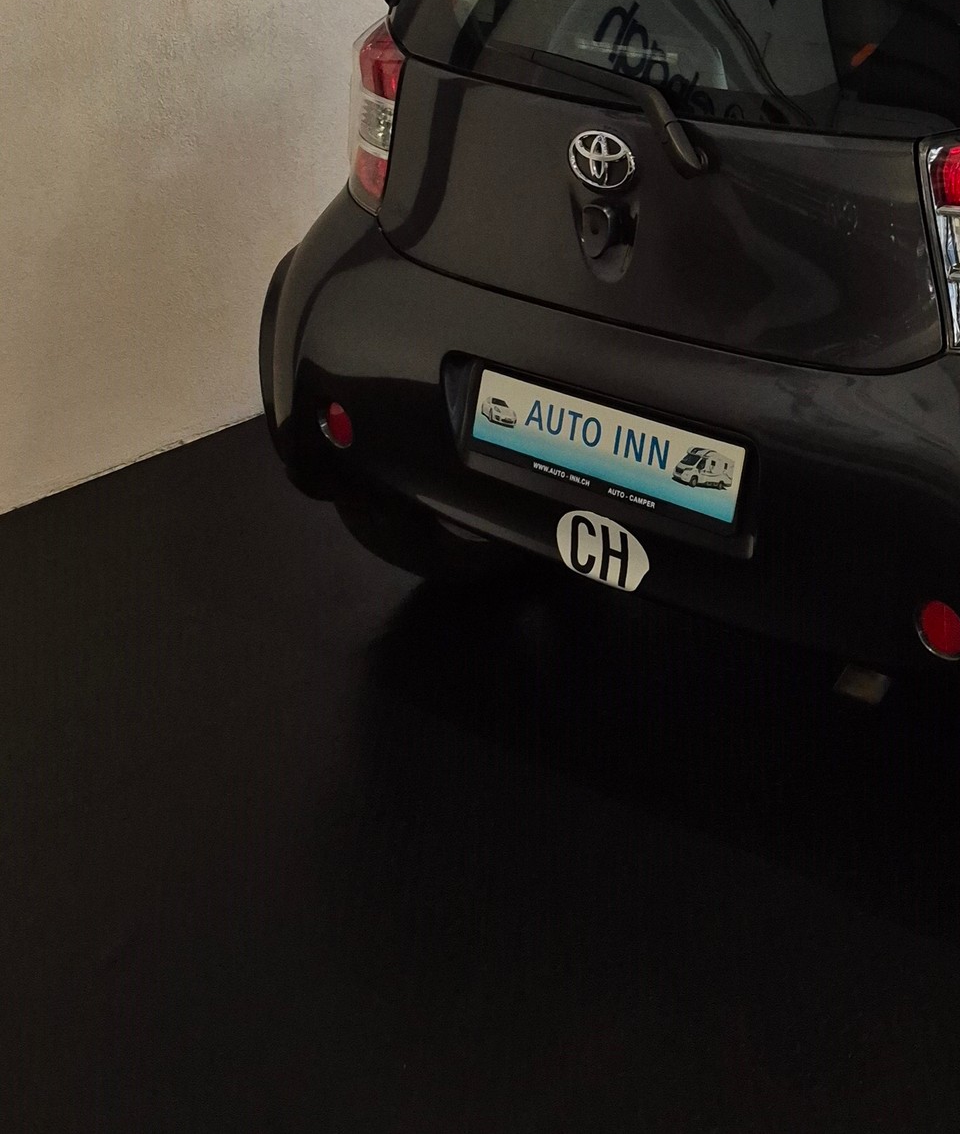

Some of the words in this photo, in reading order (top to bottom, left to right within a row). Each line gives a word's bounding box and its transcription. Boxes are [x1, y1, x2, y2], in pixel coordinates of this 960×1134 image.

[524, 399, 602, 448] AUTO
[613, 425, 670, 470] INN
[607, 487, 625, 499] AUTO
[629, 494, 656, 509] CAMPER
[570, 515, 628, 588] CH
